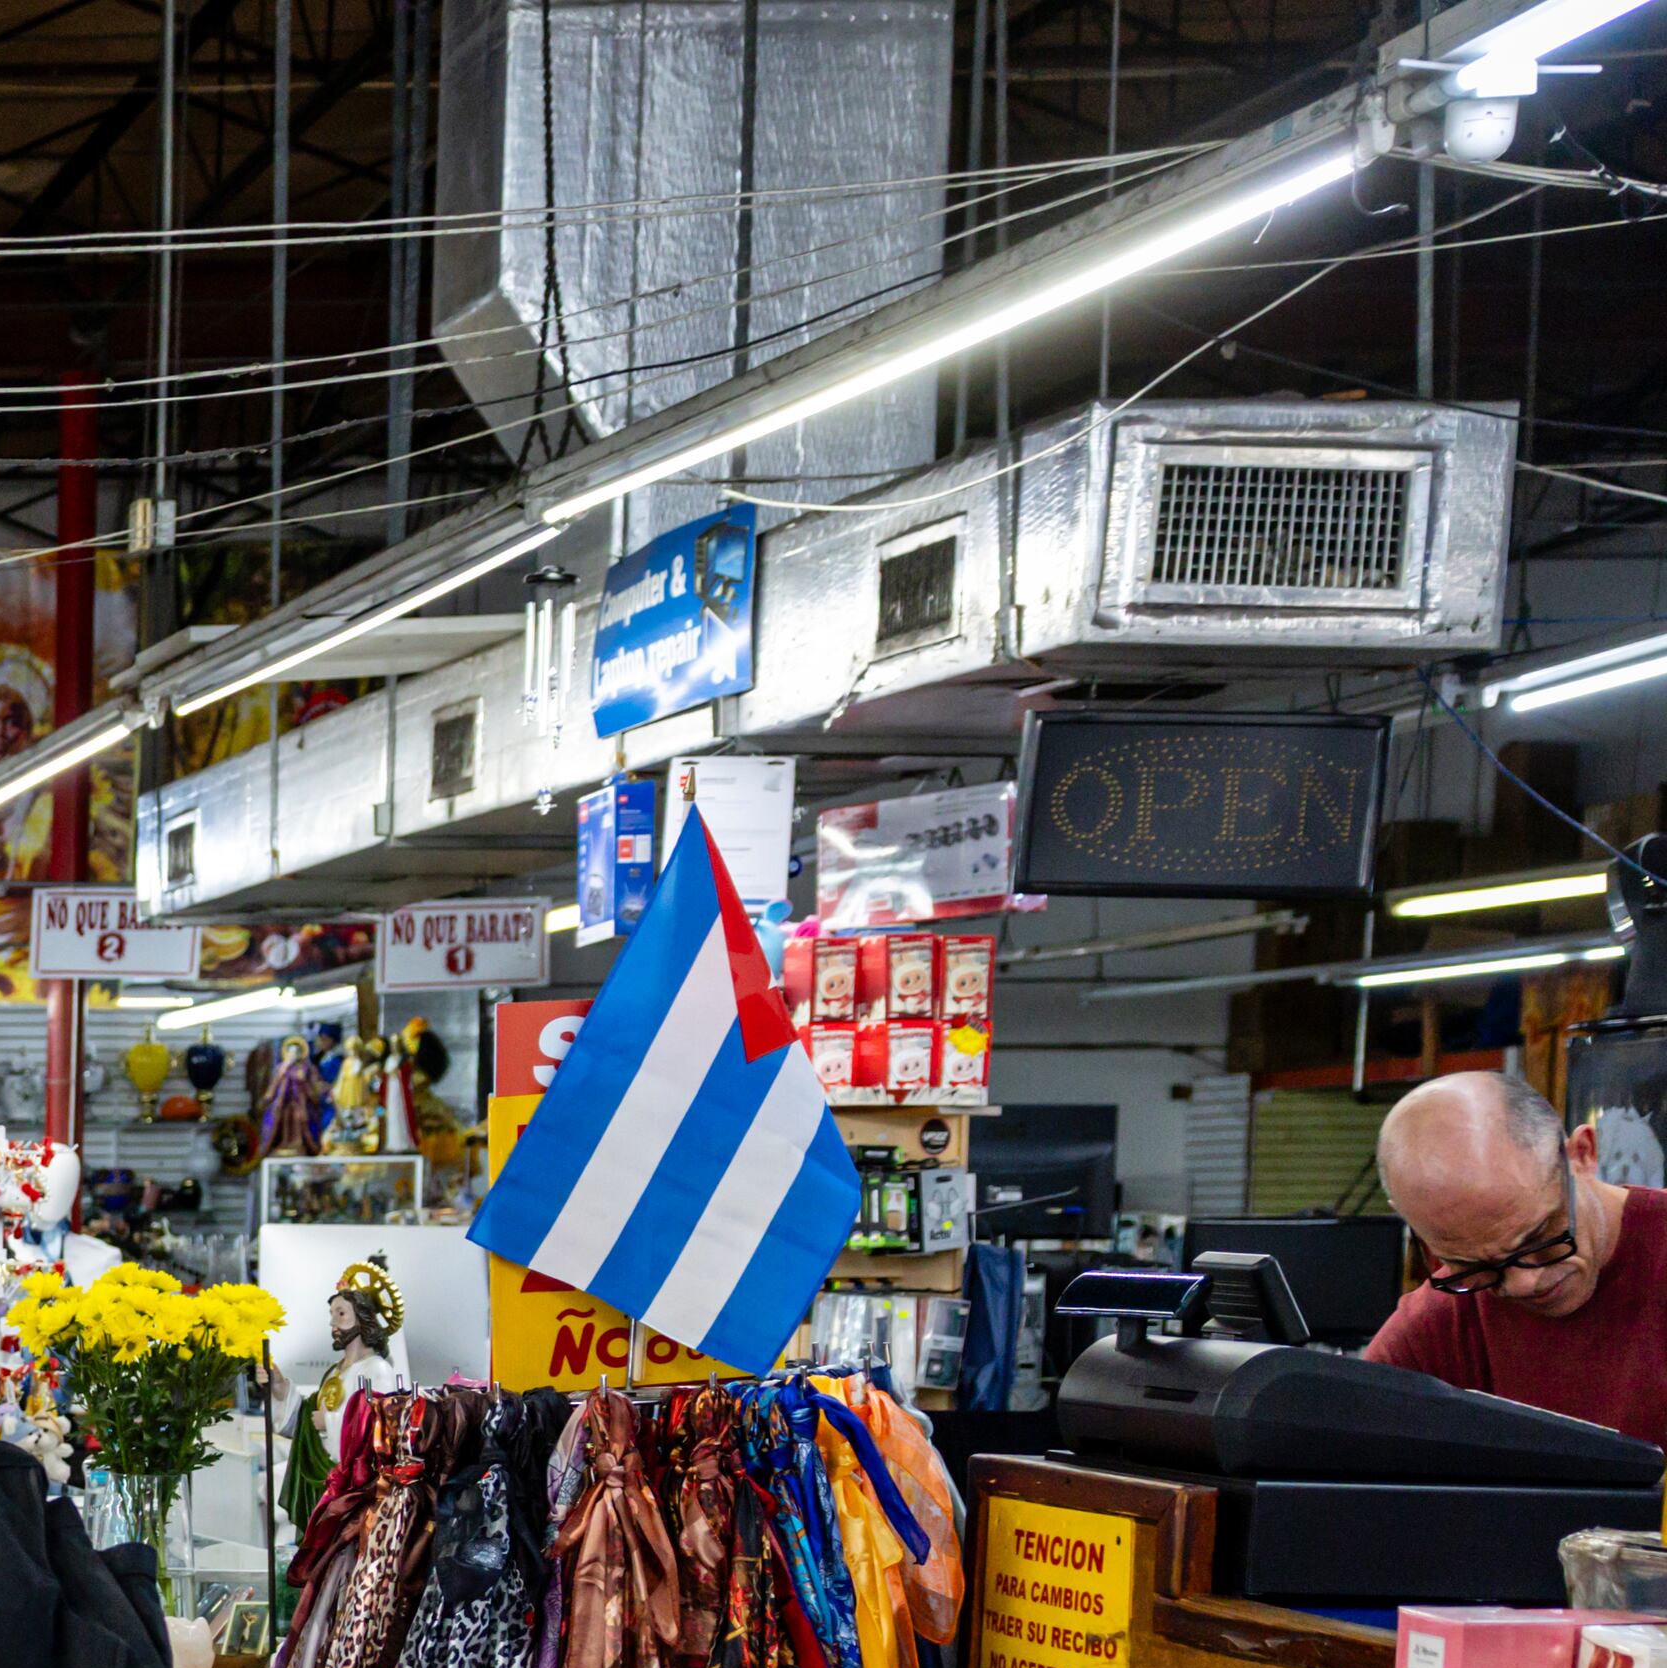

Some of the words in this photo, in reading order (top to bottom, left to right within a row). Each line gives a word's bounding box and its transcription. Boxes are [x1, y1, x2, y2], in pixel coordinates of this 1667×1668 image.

[599, 566, 668, 633] Computer
[670, 554, 687, 597] &
[593, 650, 645, 699] Laptop
[643, 619, 701, 684] repair
[1050, 761, 1363, 845] OPEN
[45, 898, 67, 931] NO
[74, 901, 112, 933] QUE
[391, 912, 416, 945] NO
[423, 914, 459, 945] QUE
[464, 912, 536, 944] BARATO
[1014, 1528, 1107, 1575] TENCION
[995, 1572, 1027, 1601] PARA
[1030, 1580, 1105, 1617] CAMBIOS
[983, 1608, 1024, 1641] TRAER
[1026, 1620, 1047, 1646] SU
[1050, 1625, 1119, 1661] RECIBO
